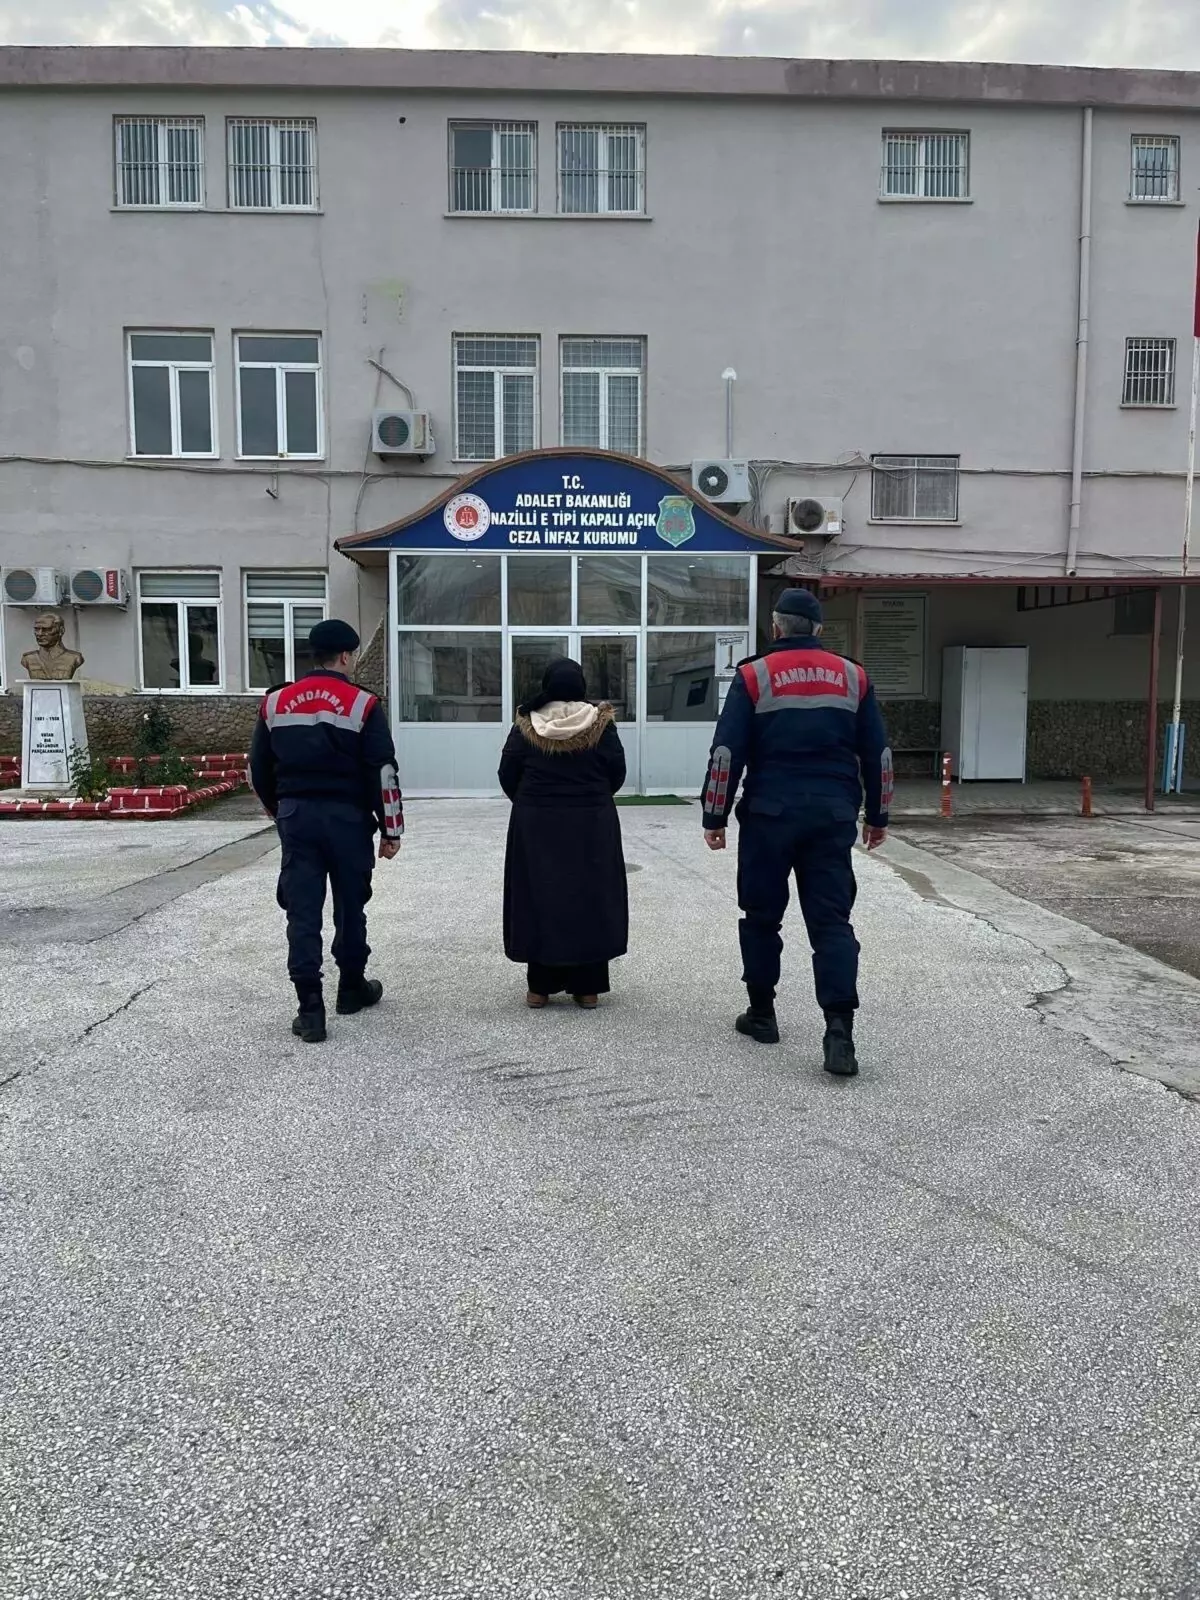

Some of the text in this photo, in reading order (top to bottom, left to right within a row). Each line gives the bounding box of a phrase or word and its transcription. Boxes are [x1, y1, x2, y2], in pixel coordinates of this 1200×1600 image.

[562, 475, 585, 489] T.C.
[516, 492, 631, 508] ADALET BAKANLIĞI
[491, 510, 656, 529] NAZİLLİ E TİPİ KAPALI AÇIK
[509, 528, 638, 545] CEZA İNFAZ KURUMU
[774, 667, 844, 688] JANDARMA
[284, 689, 345, 715] JANDARMA
